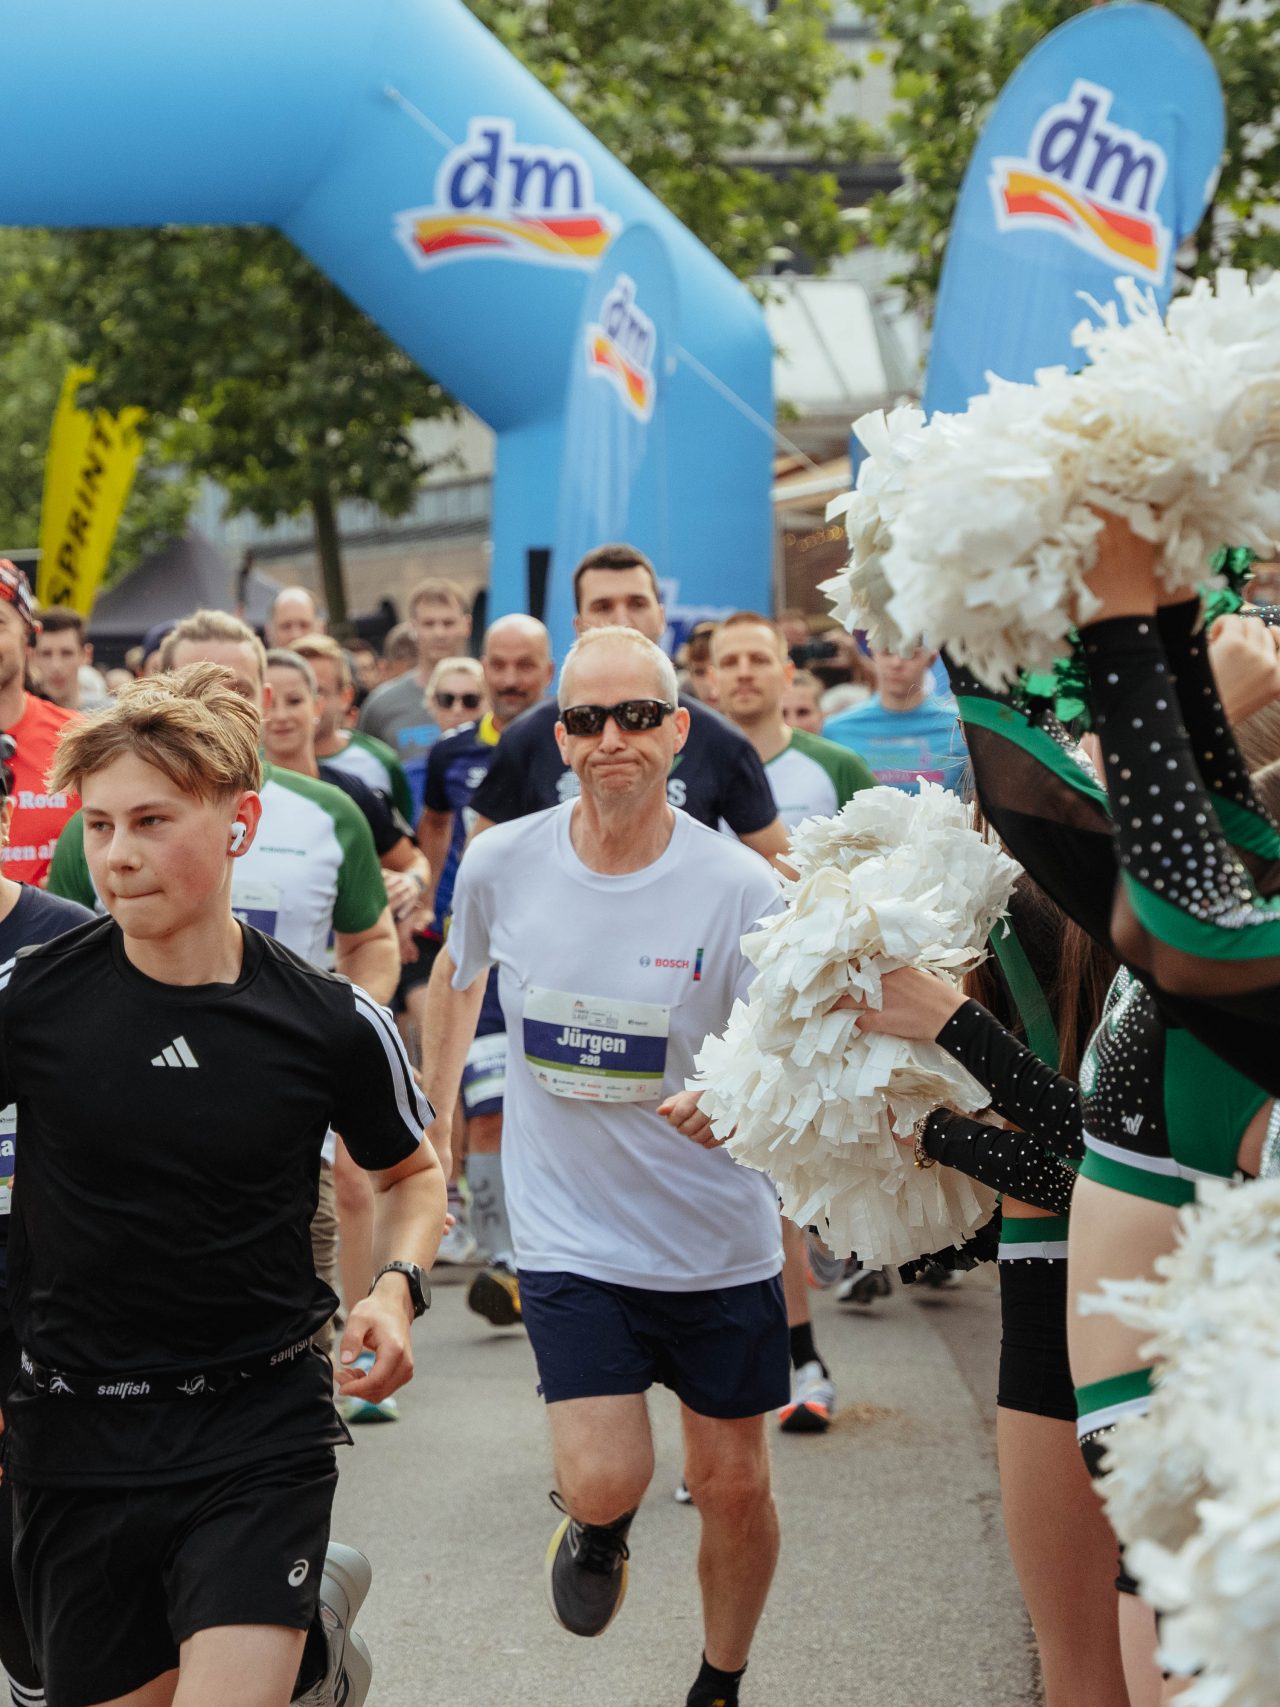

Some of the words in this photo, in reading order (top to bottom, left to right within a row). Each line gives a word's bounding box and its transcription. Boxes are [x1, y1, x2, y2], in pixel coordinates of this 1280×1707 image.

[1039, 95, 1157, 212] dm
[445, 130, 582, 210] dm
[604, 286, 649, 368] dm
[655, 958, 689, 968] BOSCH
[557, 1027, 627, 1054] Jürgen
[579, 1053, 601, 1066] 298
[97, 1381, 150, 1399] sailfish
